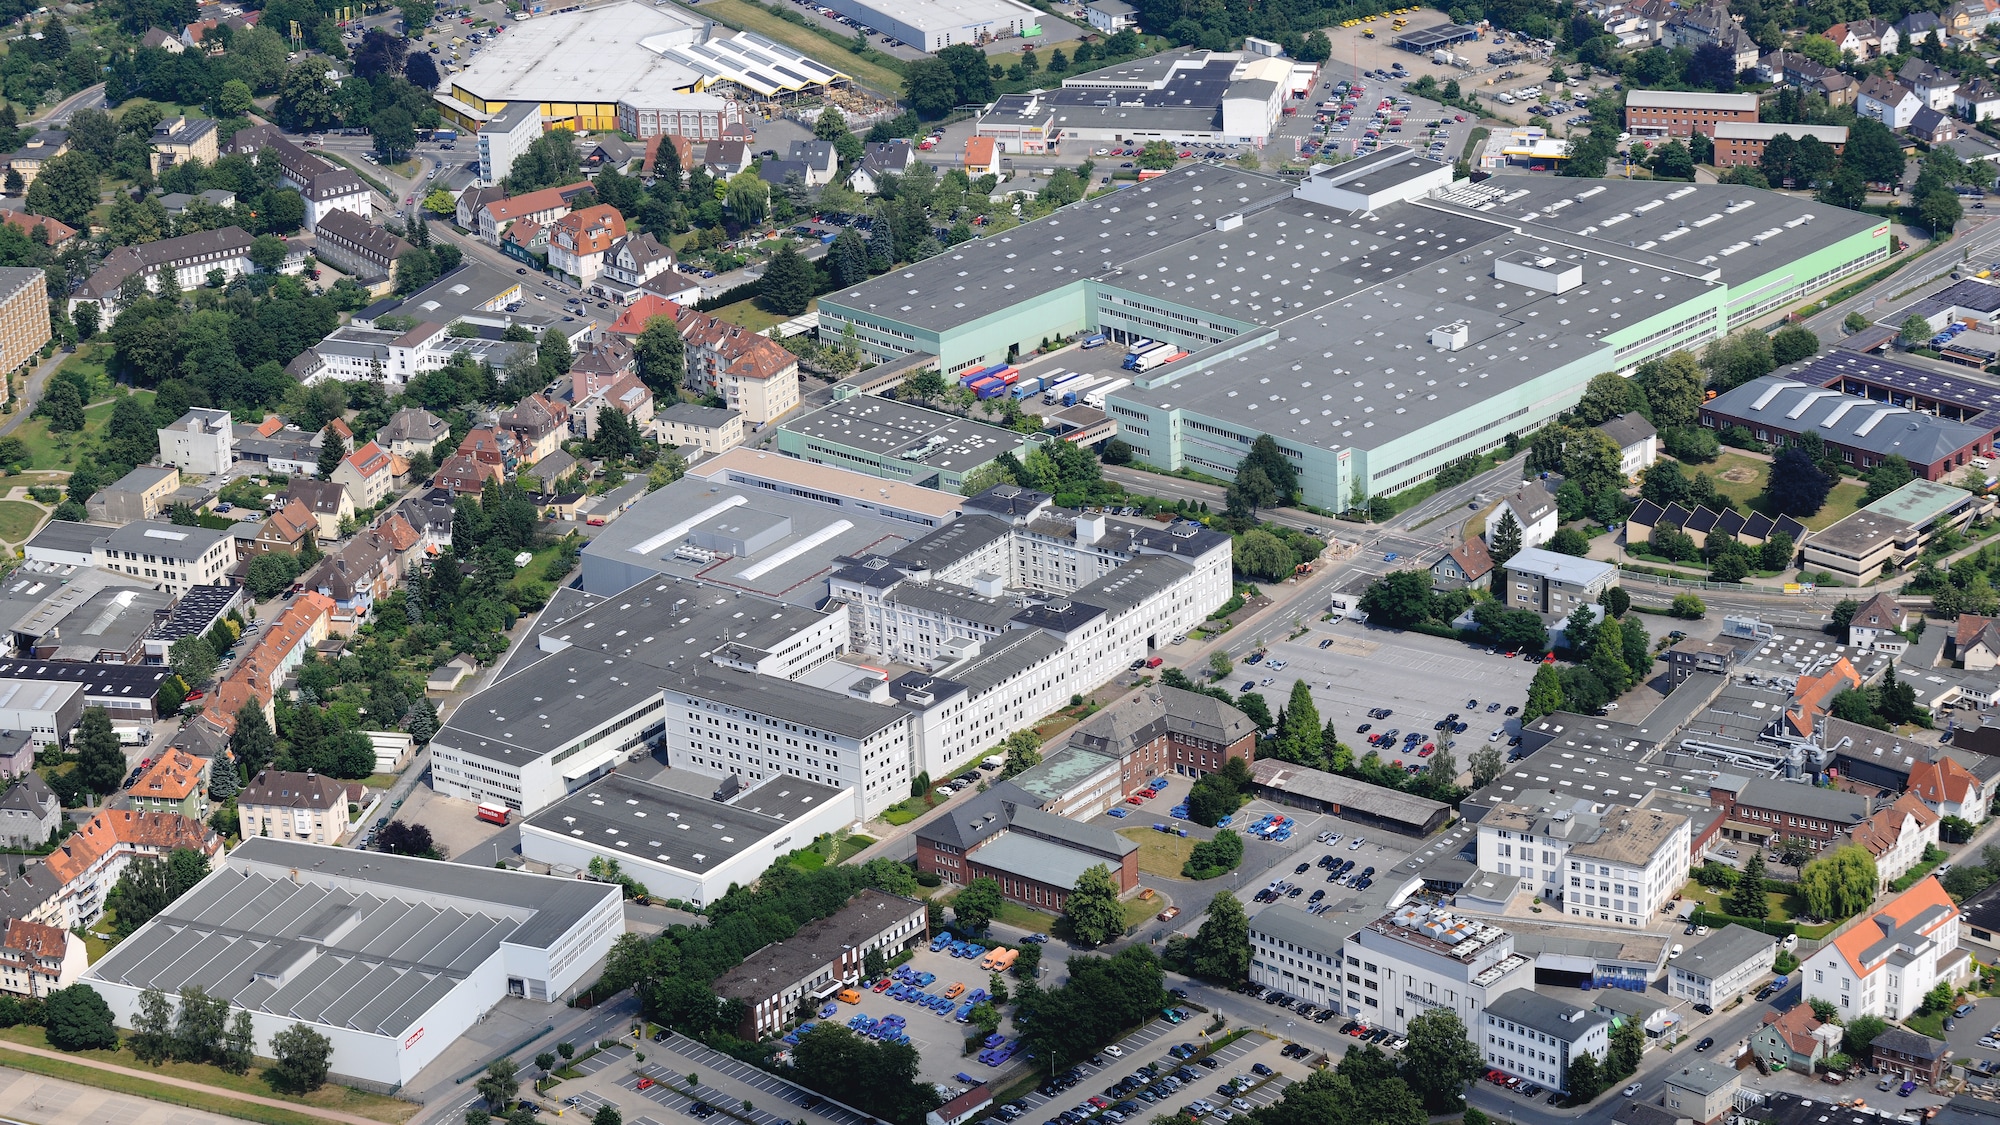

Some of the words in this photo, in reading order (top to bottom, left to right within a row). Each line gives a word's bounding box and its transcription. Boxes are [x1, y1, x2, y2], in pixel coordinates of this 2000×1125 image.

[1003, 372, 1018, 381] Miele
[478, 807, 499, 818] Miele
[406, 1030, 424, 1048] Miele
